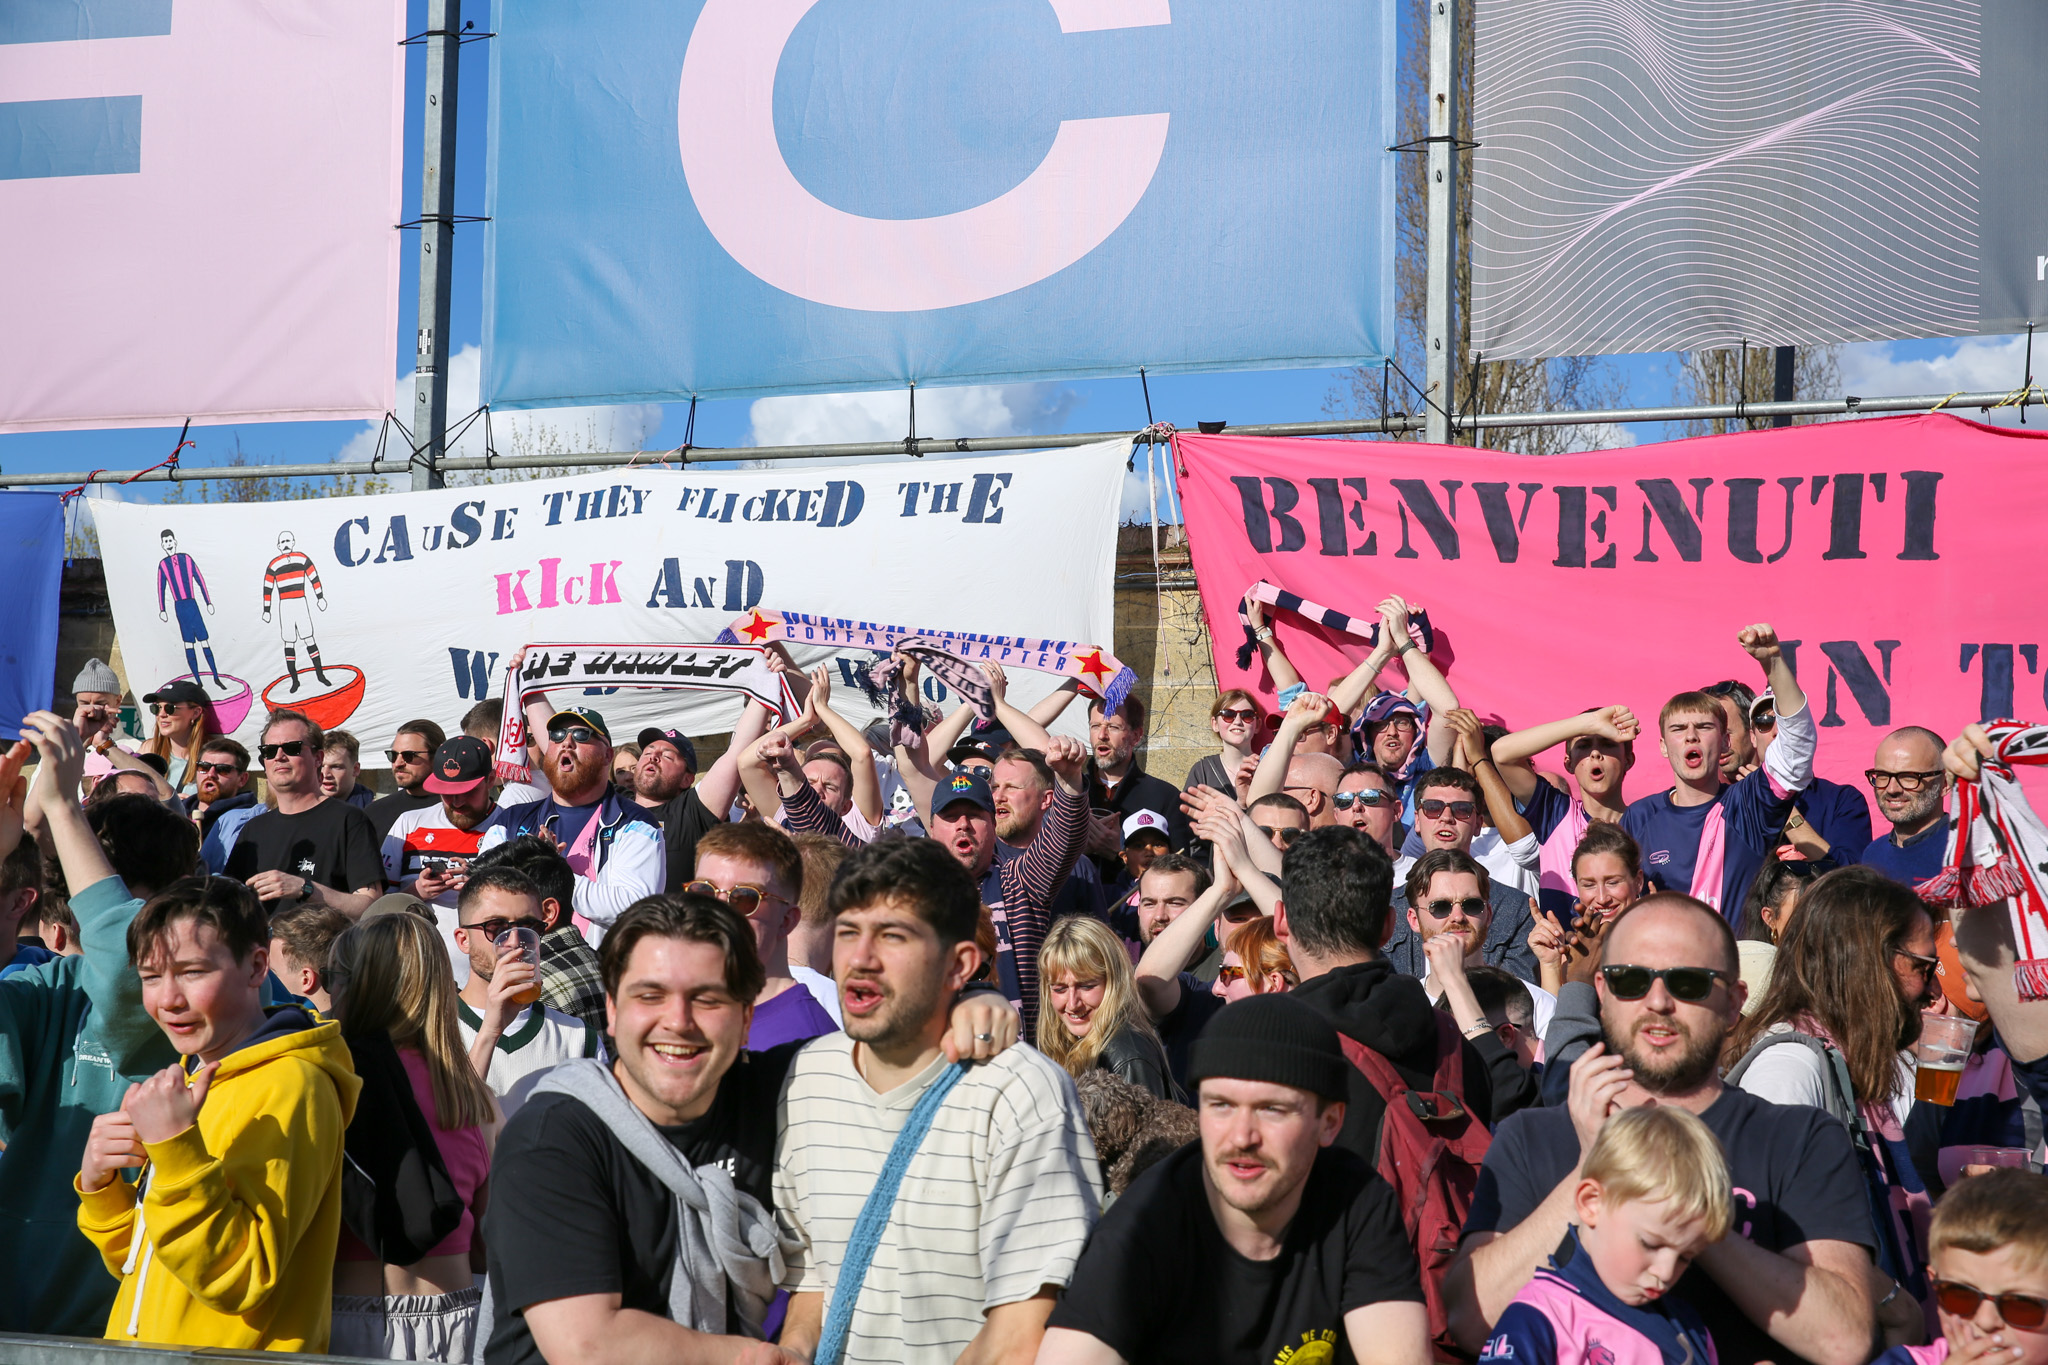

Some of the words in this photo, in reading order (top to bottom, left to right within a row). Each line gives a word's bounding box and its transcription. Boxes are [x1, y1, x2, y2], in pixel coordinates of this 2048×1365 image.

[542, 485, 652, 526] THEY
[898, 473, 1013, 524] THE
[1230, 471, 1943, 568] BENVENUTI
[785, 626, 895, 648] COMFAS
[942, 639, 1067, 671] CHAPTER
[1960, 643, 2048, 725] T
